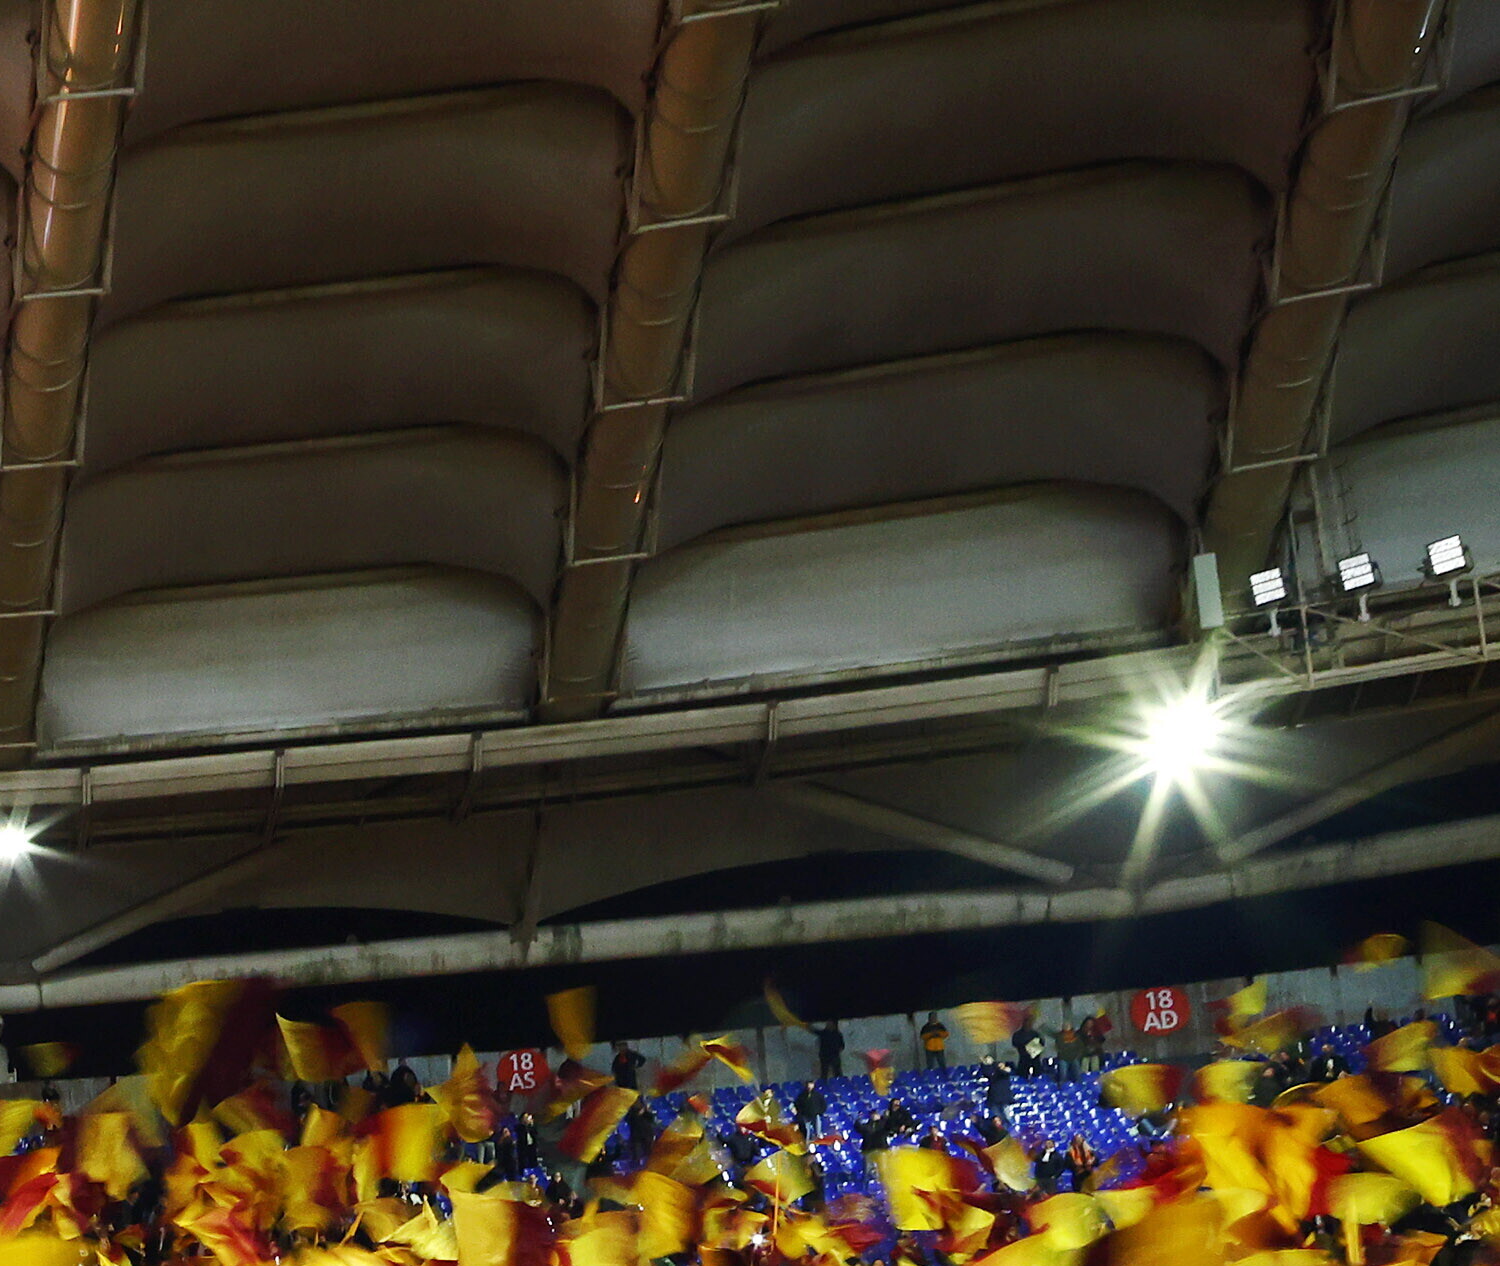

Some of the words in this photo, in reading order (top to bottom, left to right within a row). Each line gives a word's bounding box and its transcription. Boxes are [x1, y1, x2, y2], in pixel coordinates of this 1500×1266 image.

[1145, 989, 1174, 1010] 18
[1144, 1010, 1179, 1032] AD
[510, 1053, 534, 1072] 18
[509, 1071, 536, 1091] AS
